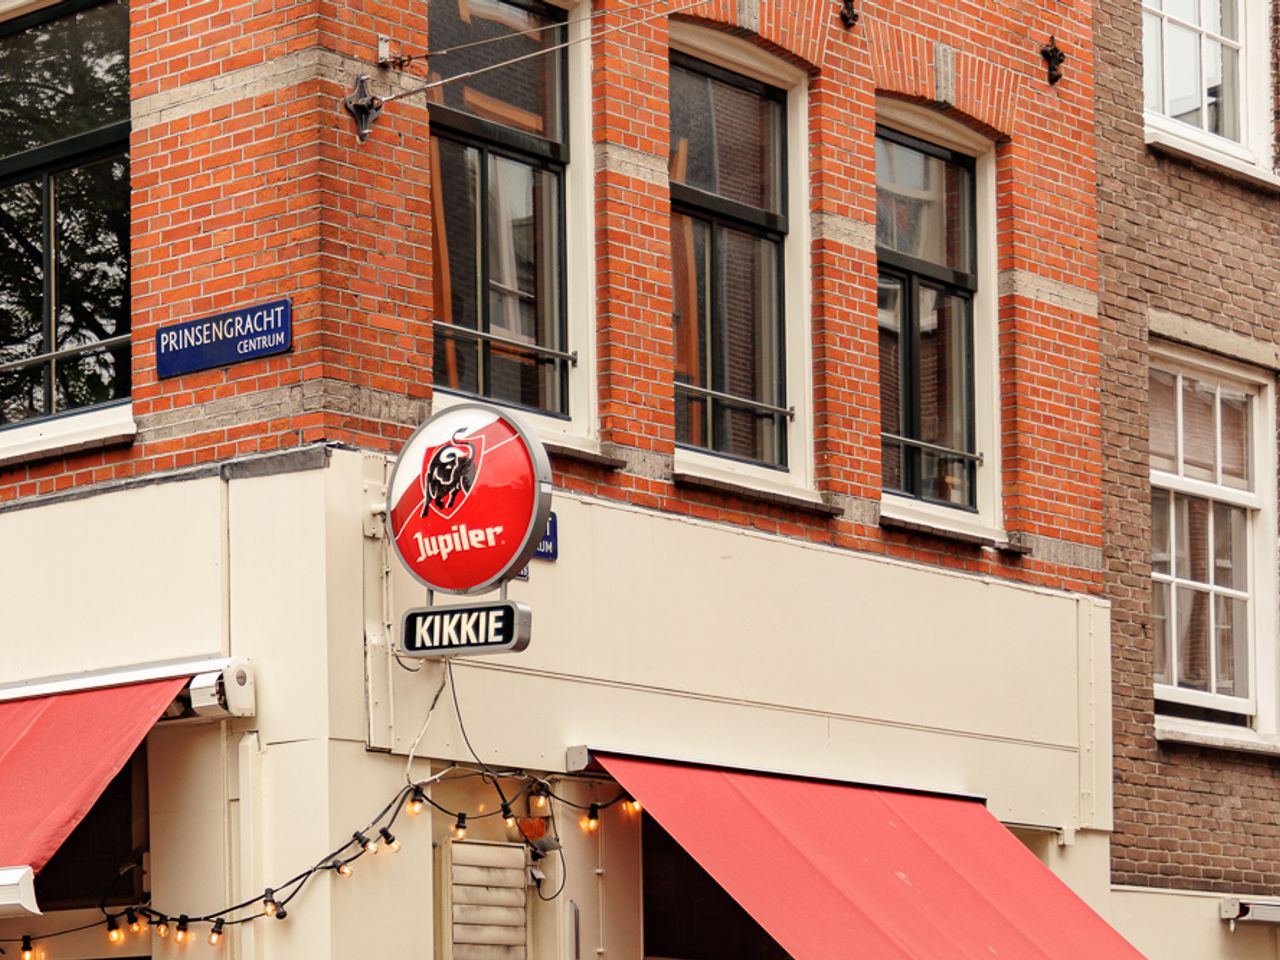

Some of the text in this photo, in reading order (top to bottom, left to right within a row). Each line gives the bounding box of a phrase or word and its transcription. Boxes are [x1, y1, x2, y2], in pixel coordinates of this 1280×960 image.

[160, 306, 285, 353] PRINSENGRACHT
[236, 331, 285, 354] CENTRUM
[413, 524, 504, 563] Jupiler
[415, 610, 504, 648] KIKKIE
